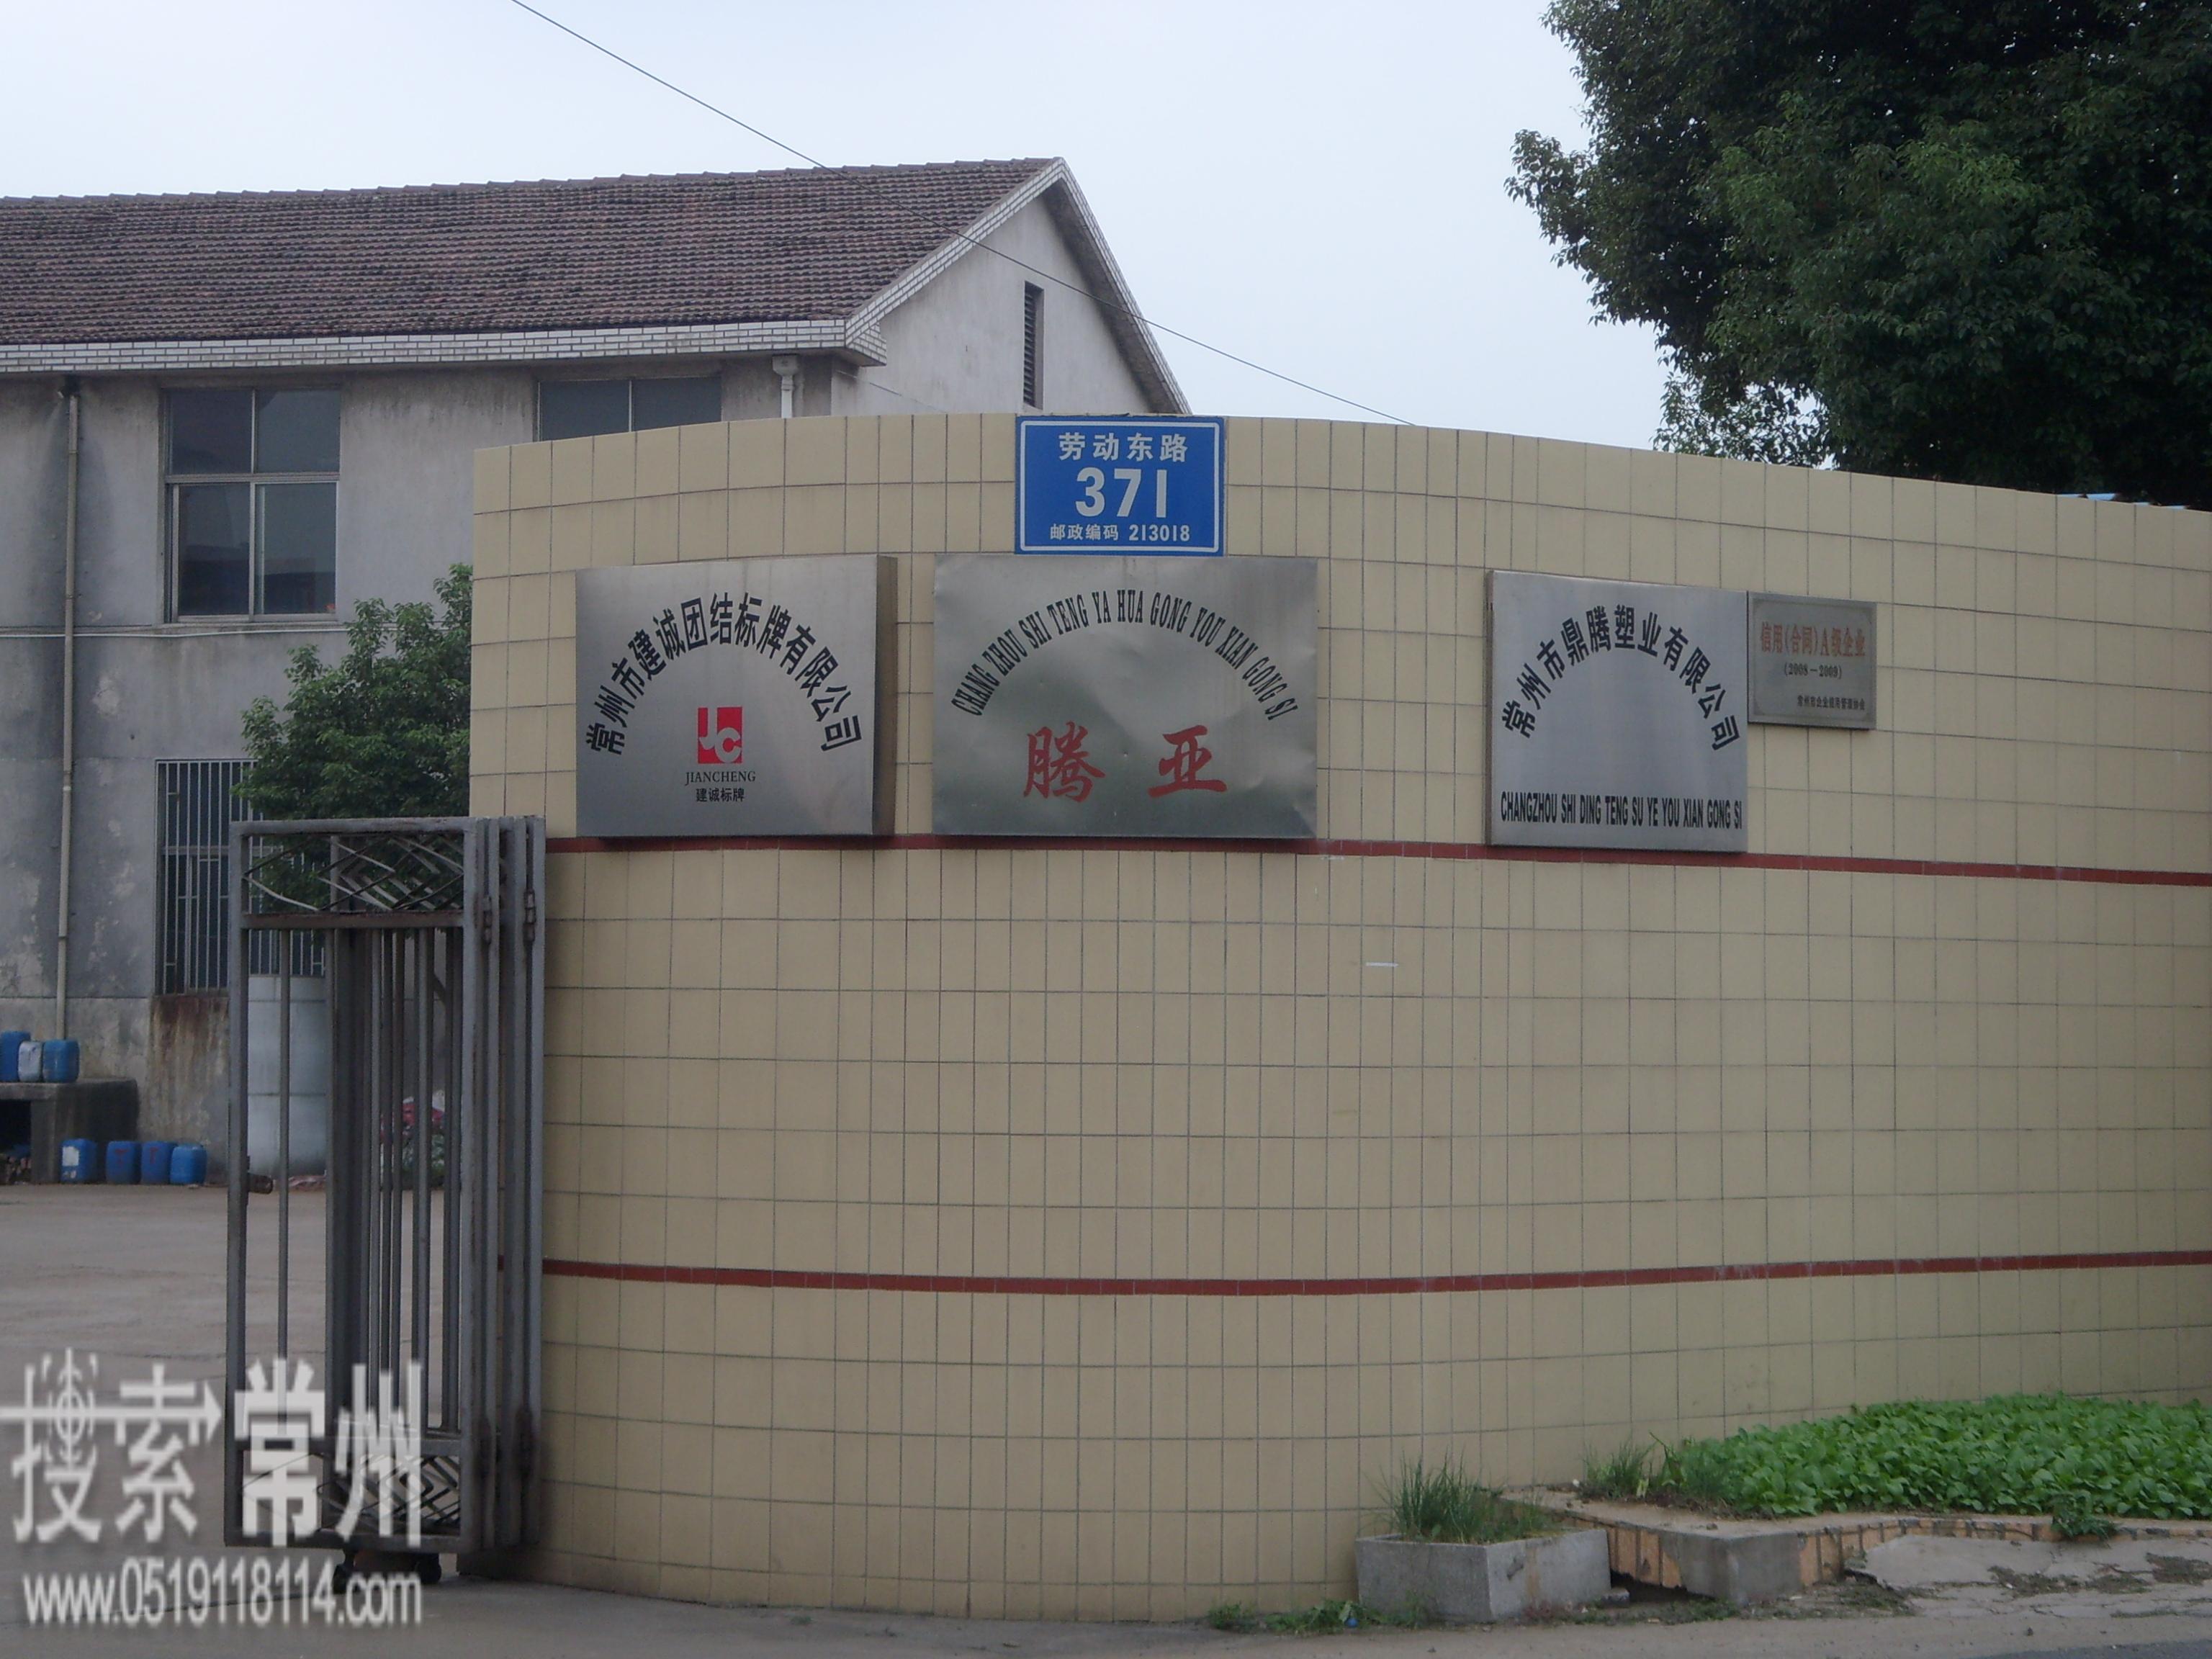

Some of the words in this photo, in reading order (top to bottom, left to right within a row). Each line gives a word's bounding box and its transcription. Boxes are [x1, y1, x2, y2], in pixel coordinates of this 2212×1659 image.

[1058, 432, 1187, 462] 劳动东路
[1075, 467, 1167, 518] 371
[1050, 524, 1118, 541] 邮政编码
[1129, 525, 1190, 541] 213018
[1046, 594, 1089, 635] TENG
[1092, 590, 1112, 624] YA
[1118, 590, 1143, 623] HUA
[1150, 592, 1192, 633] GONG
[1018, 611, 1052, 649] SHI
[1190, 607, 1226, 647] YOU
[981, 629, 1028, 676] ZHOU
[1215, 626, 1259, 670] XIAN
[585, 592, 862, 755] 常州市建诚团结标牌有限公司
[951, 664, 1000, 716] CHANG
[1242, 657, 1287, 703] GONG
[1502, 604, 1740, 751] 常州市鼎腾塑业有限公司
[1264, 698, 1298, 721] SI
[685, 770, 756, 786] JIANCHENG
[696, 788, 745, 802] 建诚标牌
[1501, 791, 1557, 823] CHANGZHOU
[1561, 793, 1576, 824] SHI
[1580, 795, 1601, 824] DING
[1605, 796, 1629, 826] TENG
[1632, 796, 1643, 826] SU
[1647, 797, 1658, 827] YE
[1662, 798, 1680, 827] YOU
[1683, 799, 1704, 828] XIAN
[1707, 799, 1731, 829] GONG
[1734, 801, 1743, 830] SI
